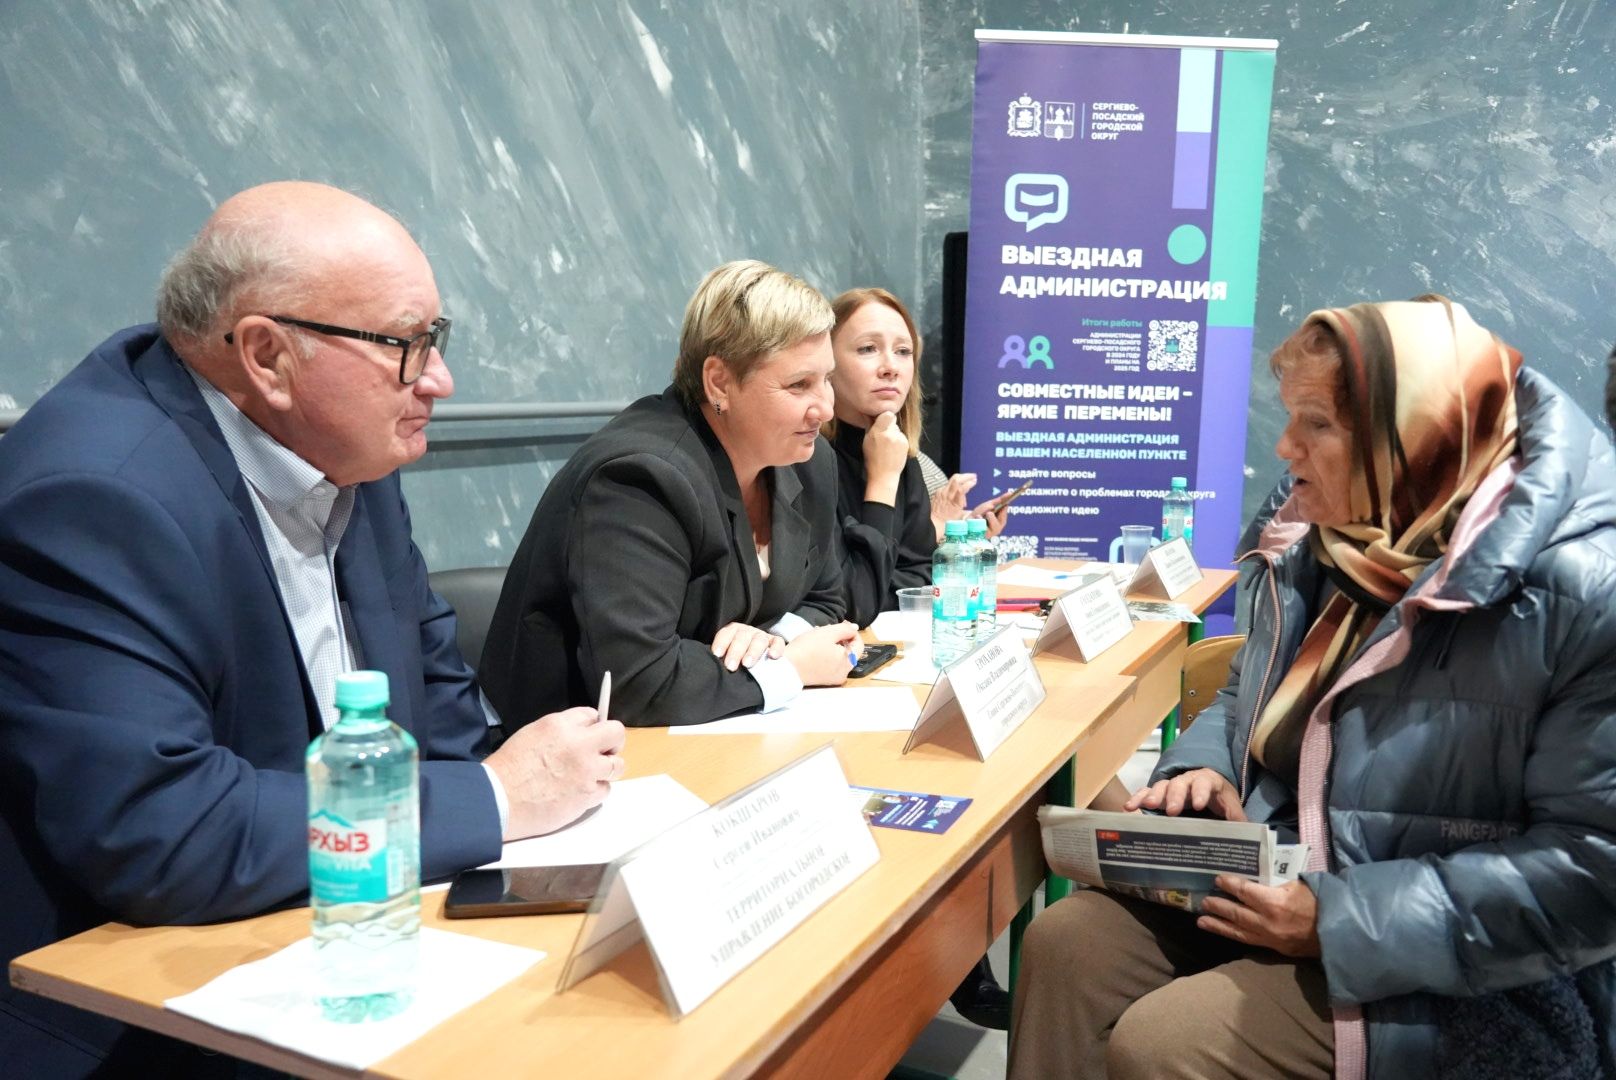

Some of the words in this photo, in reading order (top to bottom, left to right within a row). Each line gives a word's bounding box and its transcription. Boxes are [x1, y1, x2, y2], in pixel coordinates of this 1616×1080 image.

[1092, 102, 1139, 111] СЕРГИЕВО-
[1092, 112, 1144, 122] ПОСАДСКИЙ
[1091, 121, 1143, 132] ГОРОДСКОЙ
[1091, 132, 1119, 140] ОКРУГ
[1001, 244, 1143, 270] ВЫЕЗДНАЯ
[999, 275, 1228, 303] АДМИНИСТРАЦИЯ
[1082, 318, 1109, 327] Итоги
[1110, 318, 1143, 328] работы
[998, 383, 1125, 400] СОВМЕСТНЫЕ
[1128, 386, 1180, 402] ИДЕИ
[997, 404, 1058, 419] ЯРКИЕ
[1064, 405, 1172, 421] ПЕРЕМЕНЫ!
[996, 431, 1065, 444] ВЫЕЗДНАЯ
[1067, 432, 1180, 446] АДМИНИСТРАЦИЯ
[995, 447, 1003, 457] В
[1006, 447, 1050, 458] ВАШЕМ
[1052, 448, 1136, 460] НАСЕЛЕННОМ
[1139, 449, 1187, 460] ПУНКТЕ
[1008, 468, 1050, 479] задайте
[1051, 469, 1096, 480] вопросы
[1070, 489, 1077, 497] о
[1079, 487, 1134, 500] проблемах
[1007, 505, 1070, 517] предложите
[1071, 506, 1099, 516] идею
[712, 788, 781, 838] КОКШАРОВ
[751, 808, 800, 845] Иванович
[726, 844, 826, 924] ТЕРРИТОРИАЛЬНОЕ
[710, 900, 786, 968] УПРАВЛЕНИЕ
[785, 851, 852, 909] БОГОРОДСКОЕ
